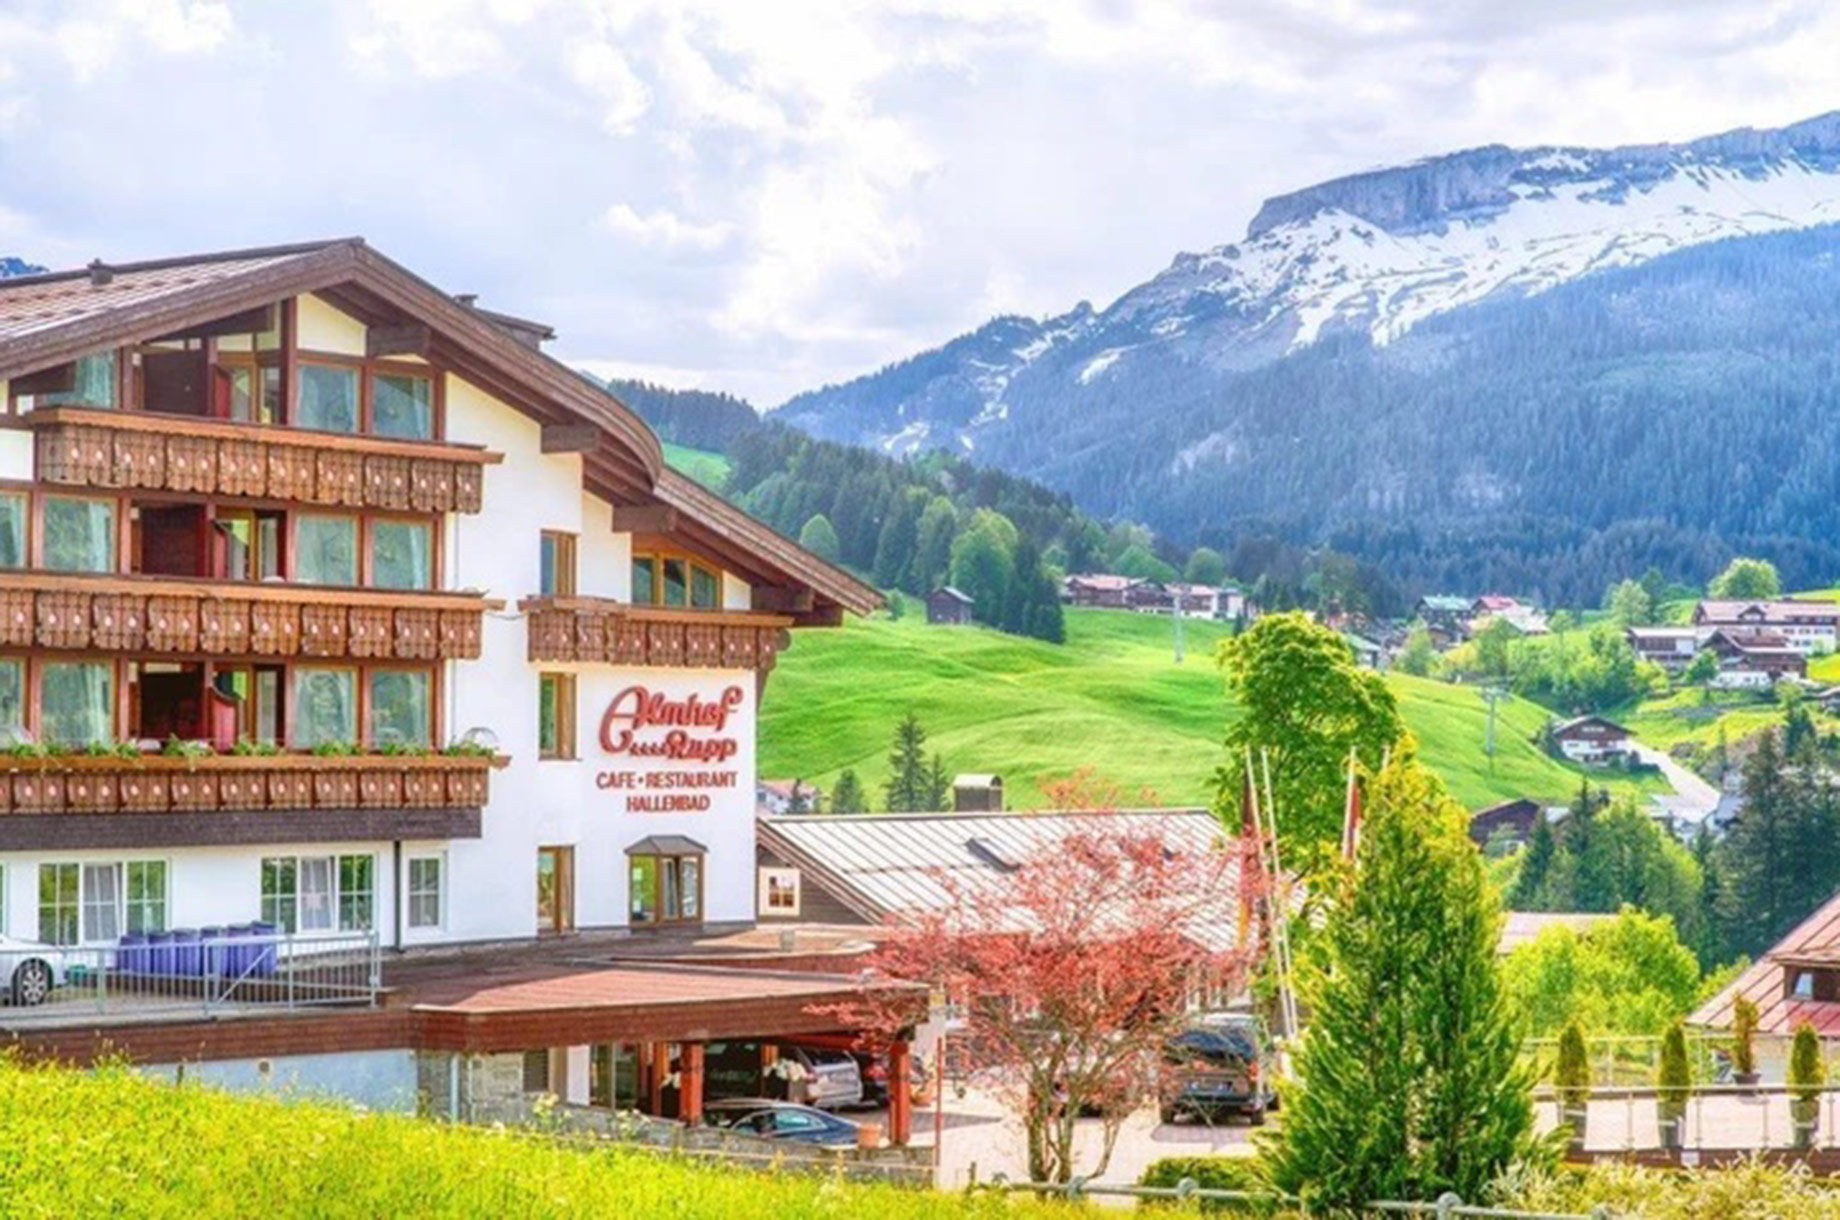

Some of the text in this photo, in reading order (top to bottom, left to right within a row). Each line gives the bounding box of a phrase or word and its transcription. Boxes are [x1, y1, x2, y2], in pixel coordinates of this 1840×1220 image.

[599, 685, 744, 753] Almhof
[666, 730, 737, 762] Rupp
[596, 771, 738, 790] CAFE RESTAURANT
[626, 794, 711, 812] HALLENBAD
